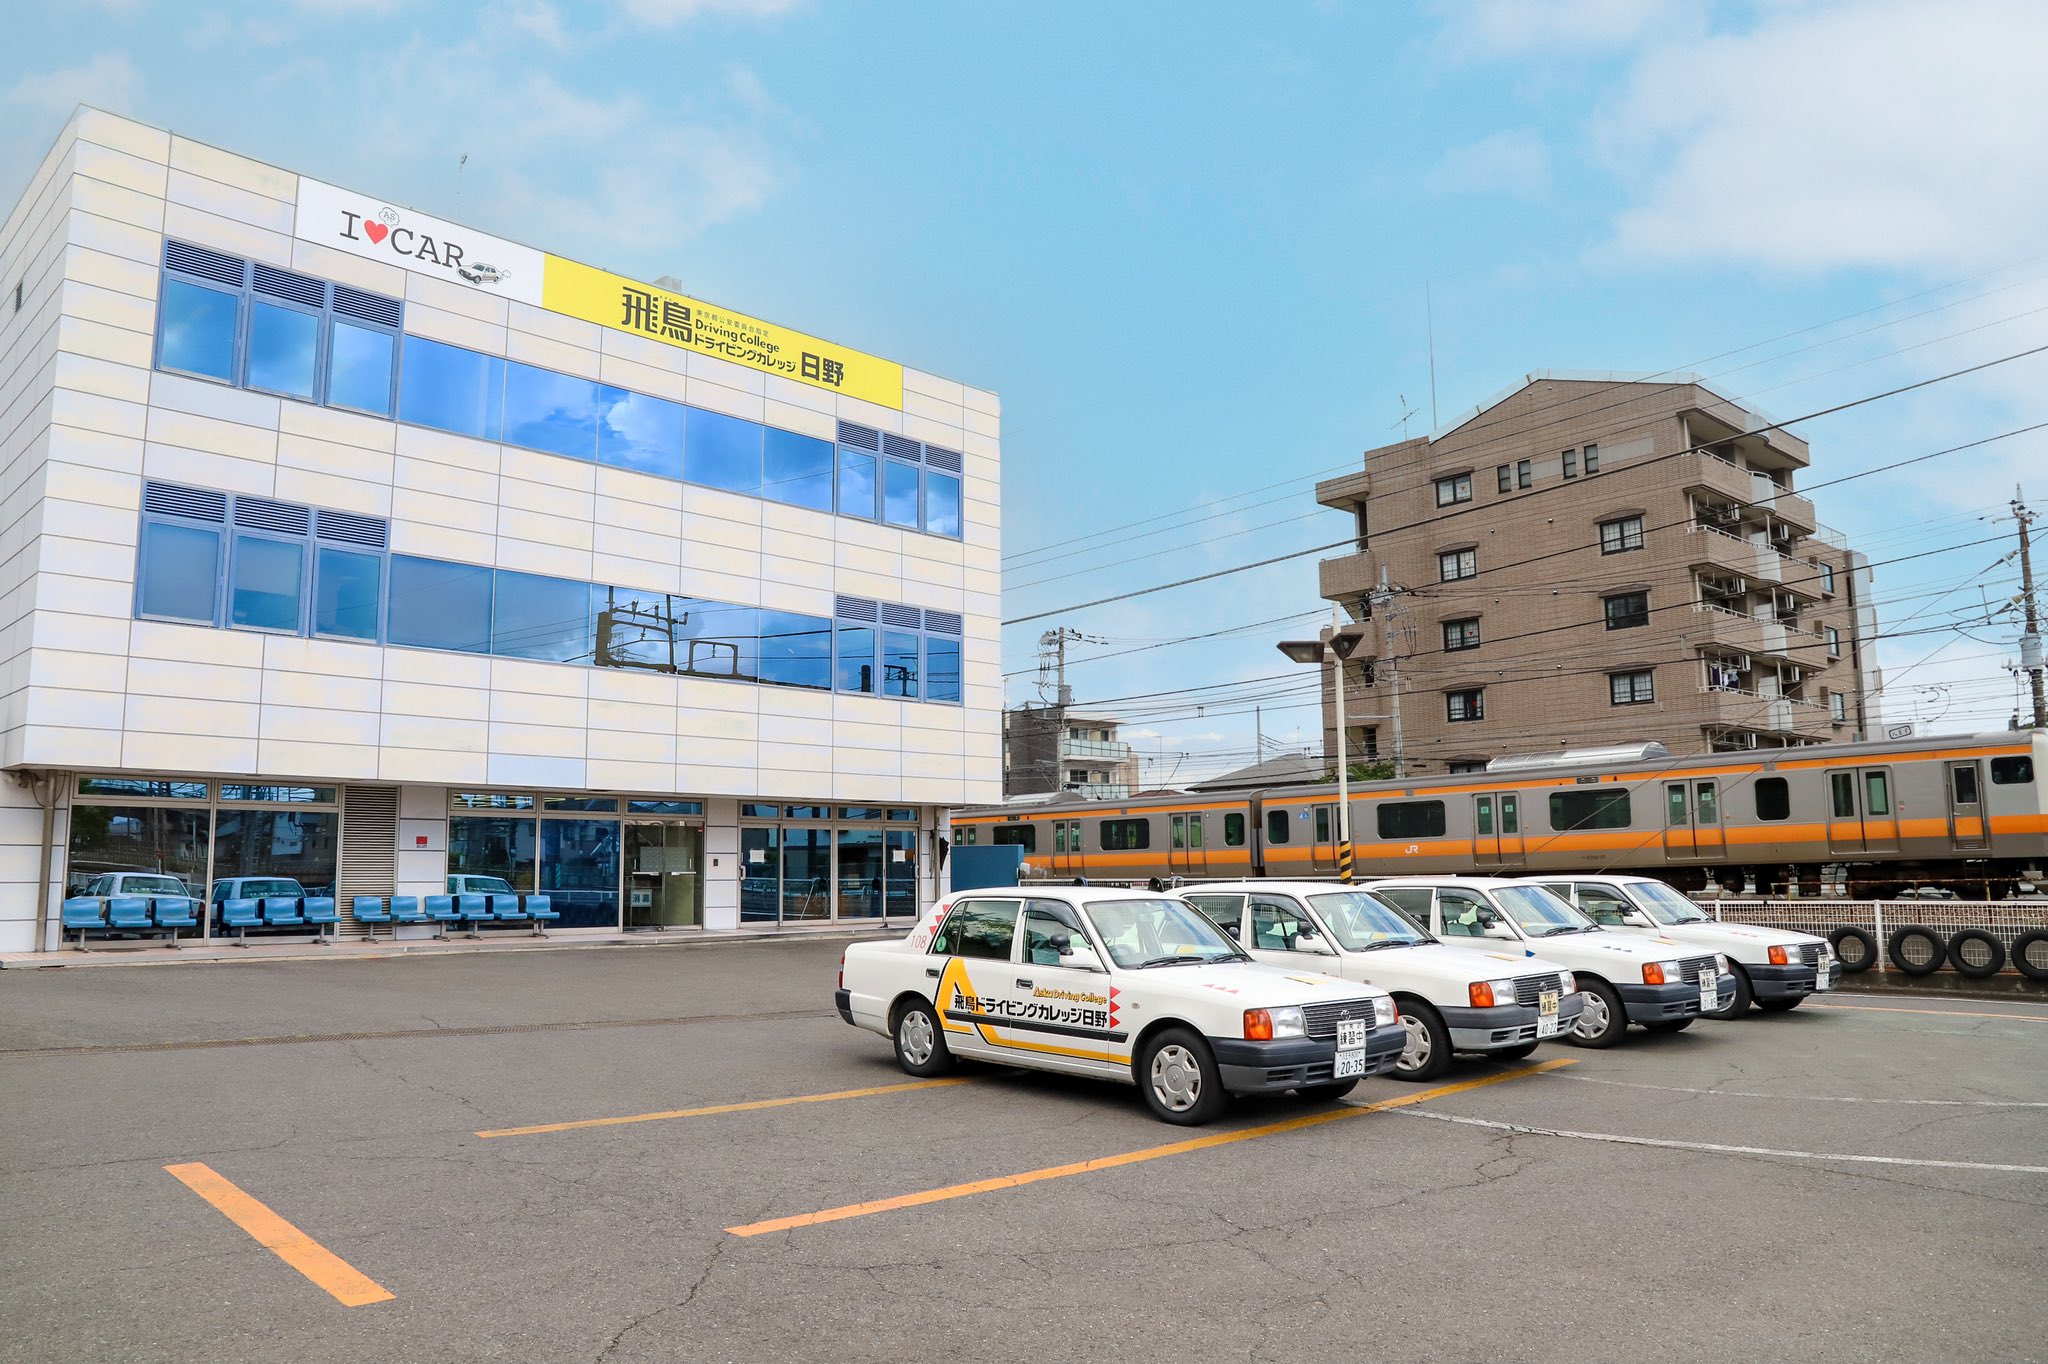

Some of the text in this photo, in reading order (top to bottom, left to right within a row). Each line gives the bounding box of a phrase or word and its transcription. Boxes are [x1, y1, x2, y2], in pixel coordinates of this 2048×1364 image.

[339, 210, 463, 267] I CAR
[621, 286, 692, 343] 飛鳥
[694, 333, 797, 373] ドライビングカレッジ
[695, 318, 780, 354] Driving College
[801, 351, 844, 387] 日野
[1405, 845, 1419, 854] JR
[911, 934, 928, 949] 108
[954, 994, 1108, 1028] 飛鳥ドライビングカレッジ日野
[1053, 989, 1080, 1003] Driving
[1080, 992, 1108, 1005] College
[1340, 1058, 1363, 1075] 20-35
